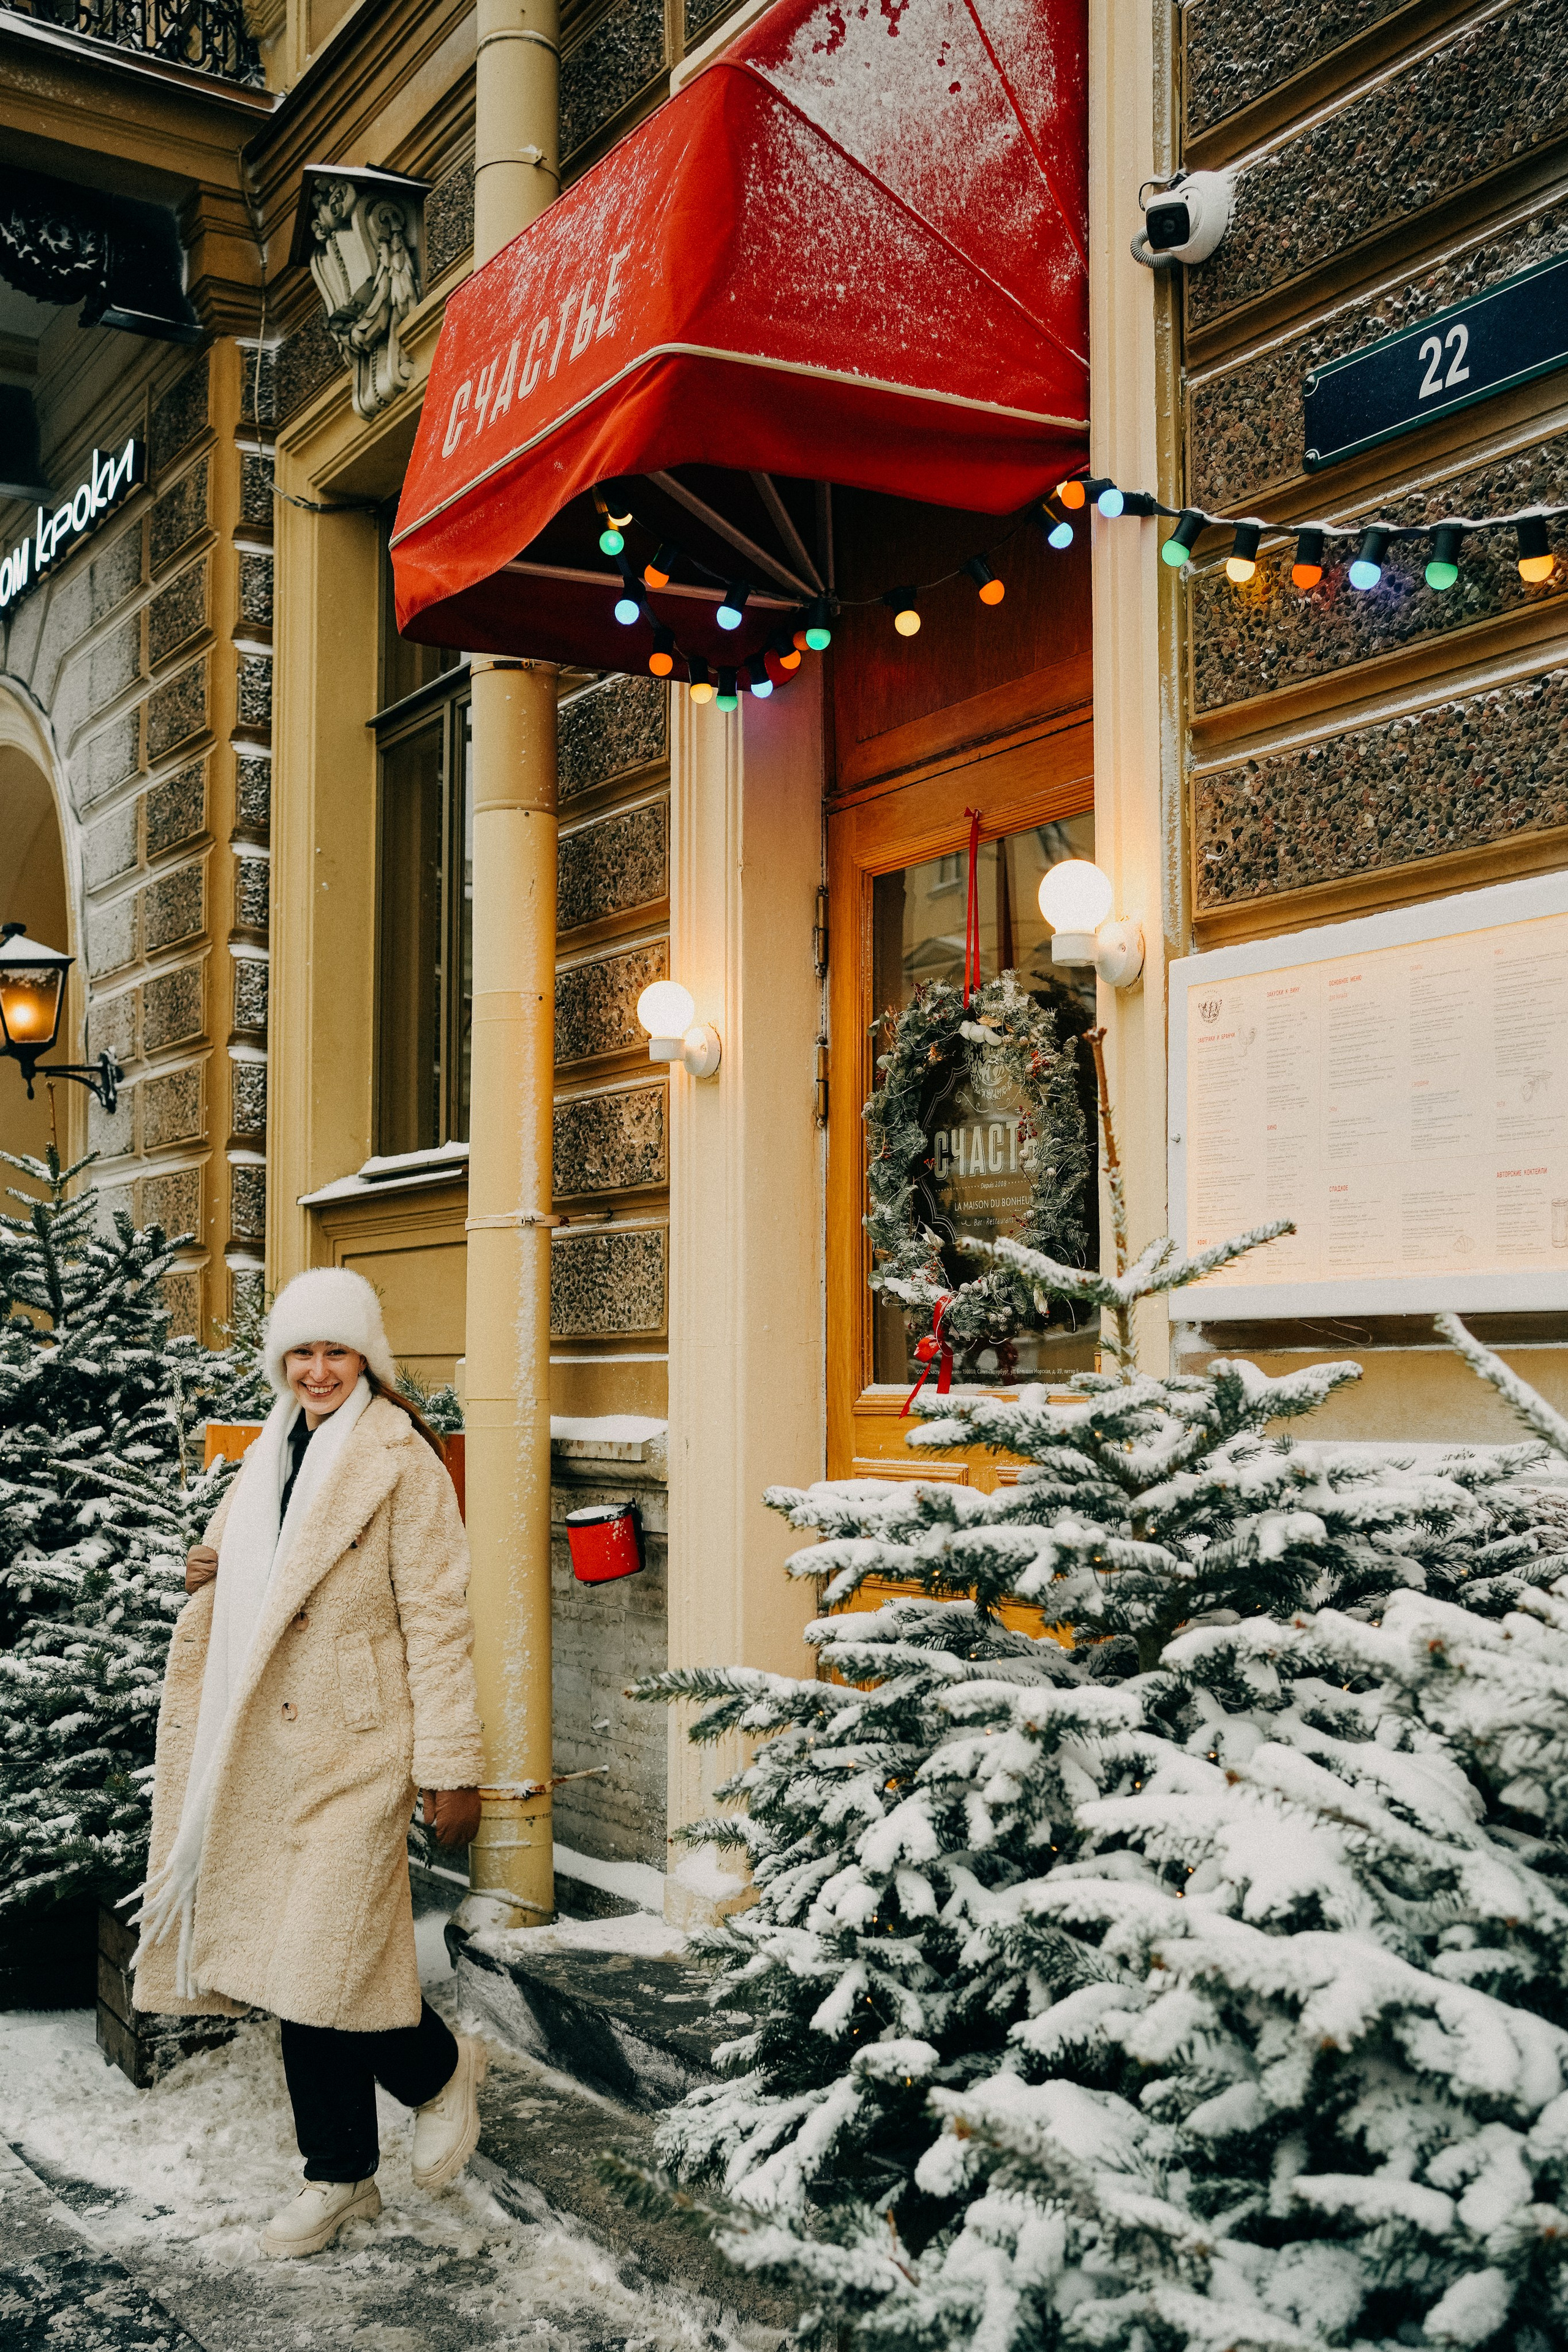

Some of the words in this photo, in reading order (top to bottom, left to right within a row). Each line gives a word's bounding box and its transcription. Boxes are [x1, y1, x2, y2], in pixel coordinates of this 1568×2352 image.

[442, 244, 631, 461] СЧАСТЬЕ
[1418, 324, 1469, 399] 22
[1329, 977, 1348, 986] ОСНОВНОЕ
[934, 1120, 1039, 1181] СЧАСТЬ
[954, 1202, 962, 1212] LA
[963, 1200, 989, 1210] MAISON
[990, 1198, 1000, 1207] DU
[1001, 1195, 1035, 1207] BONHEUR
[986, 1216, 1014, 1225] Restaurant
